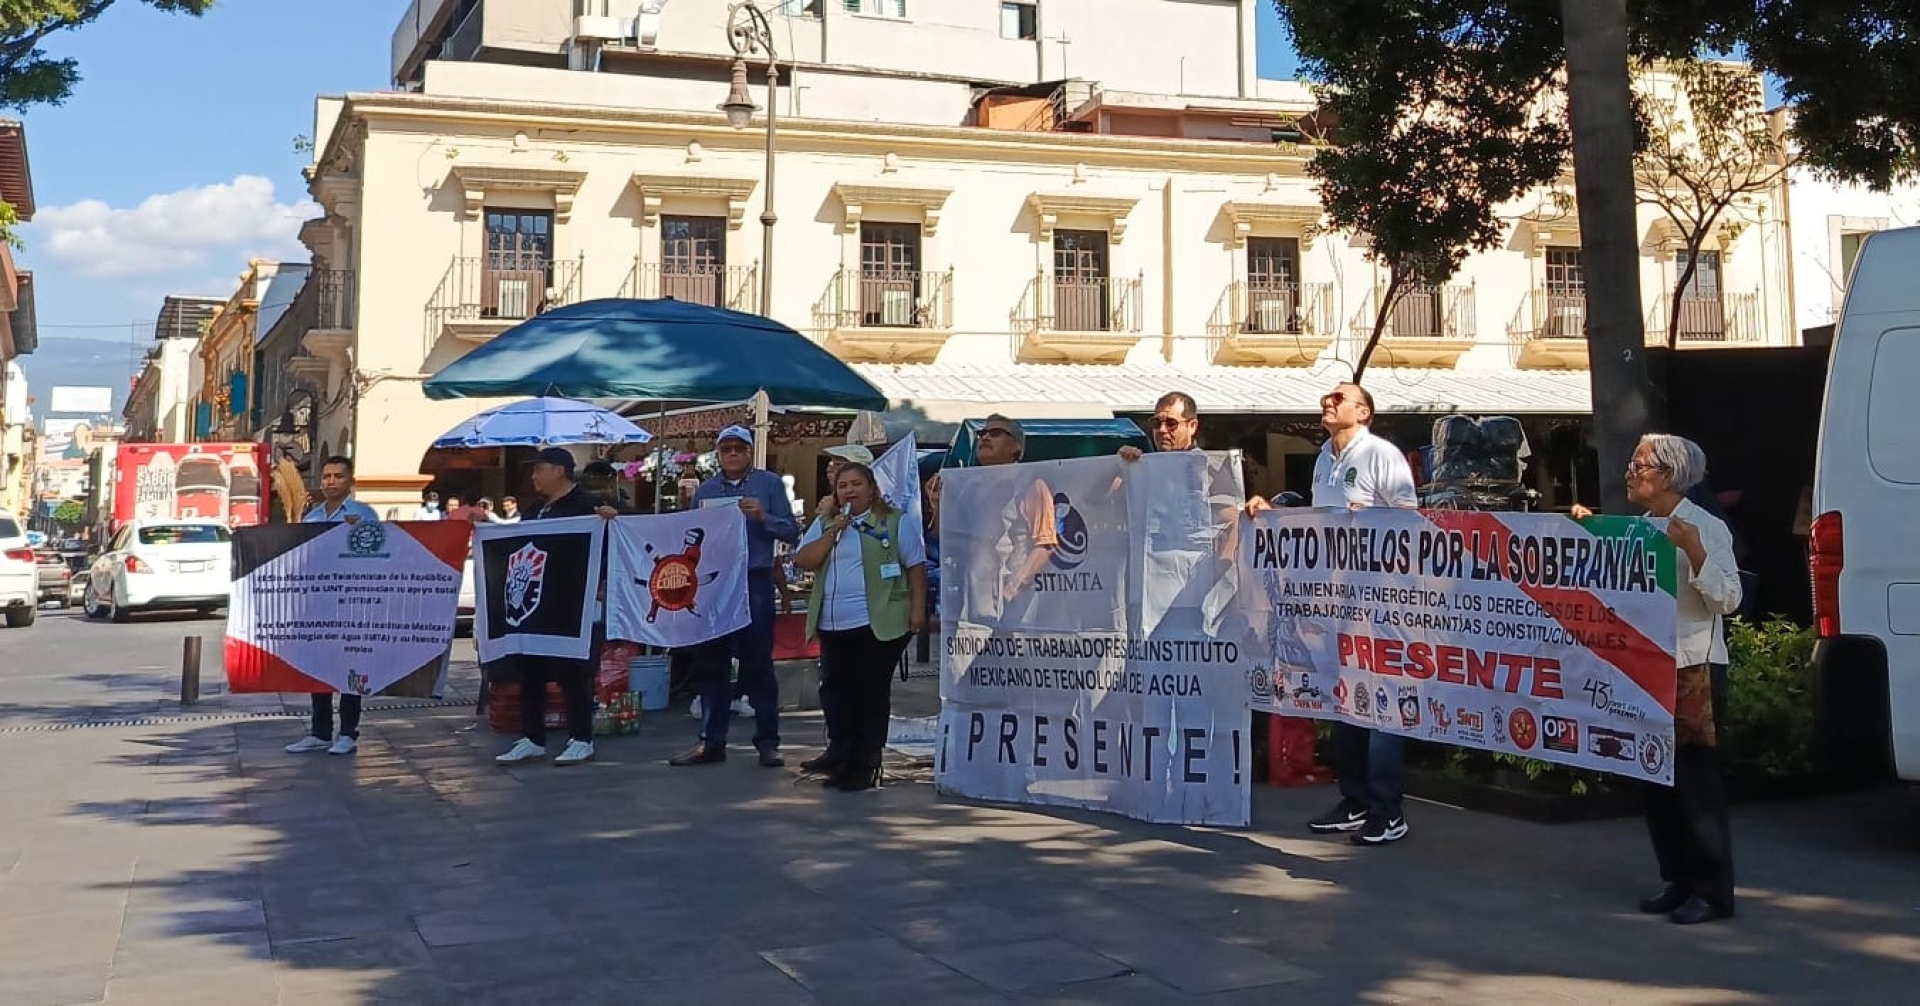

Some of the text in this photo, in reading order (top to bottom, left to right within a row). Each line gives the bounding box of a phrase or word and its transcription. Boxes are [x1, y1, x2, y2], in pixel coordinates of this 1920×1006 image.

[1253, 524, 1657, 593] PACTO MORELOS POR LA SOBERANÍA:
[323, 584, 344, 593] UNT
[435, 585, 458, 595] total
[1034, 572, 1104, 592] SITIMTA
[1364, 585, 1451, 612] ENERGÉTICA,
[1453, 595, 1482, 612] LOS
[1487, 596, 1566, 620] DERECHOS
[1566, 604, 1584, 622] DE
[1588, 607, 1617, 625] LOS
[1363, 608, 1371, 622] Y
[1374, 609, 1400, 626] LAS
[1404, 612, 1482, 635] GARANTÍAS
[1486, 620, 1627, 651] CONSTITUCIONALES
[947, 636, 1004, 657] SINDICATO
[1006, 637, 1024, 657] DE
[1025, 637, 1127, 659] TRABAJADORES
[1144, 640, 1239, 663] INSTITUTO
[970, 666, 1032, 688] MEXICANO
[1034, 668, 1052, 688] DE
[1053, 666, 1127, 693] TECNOLOGÍA
[1148, 674, 1202, 696] AGUA
[1337, 632, 1565, 700] PRESENTE
[1544, 718, 1577, 740] OPT
